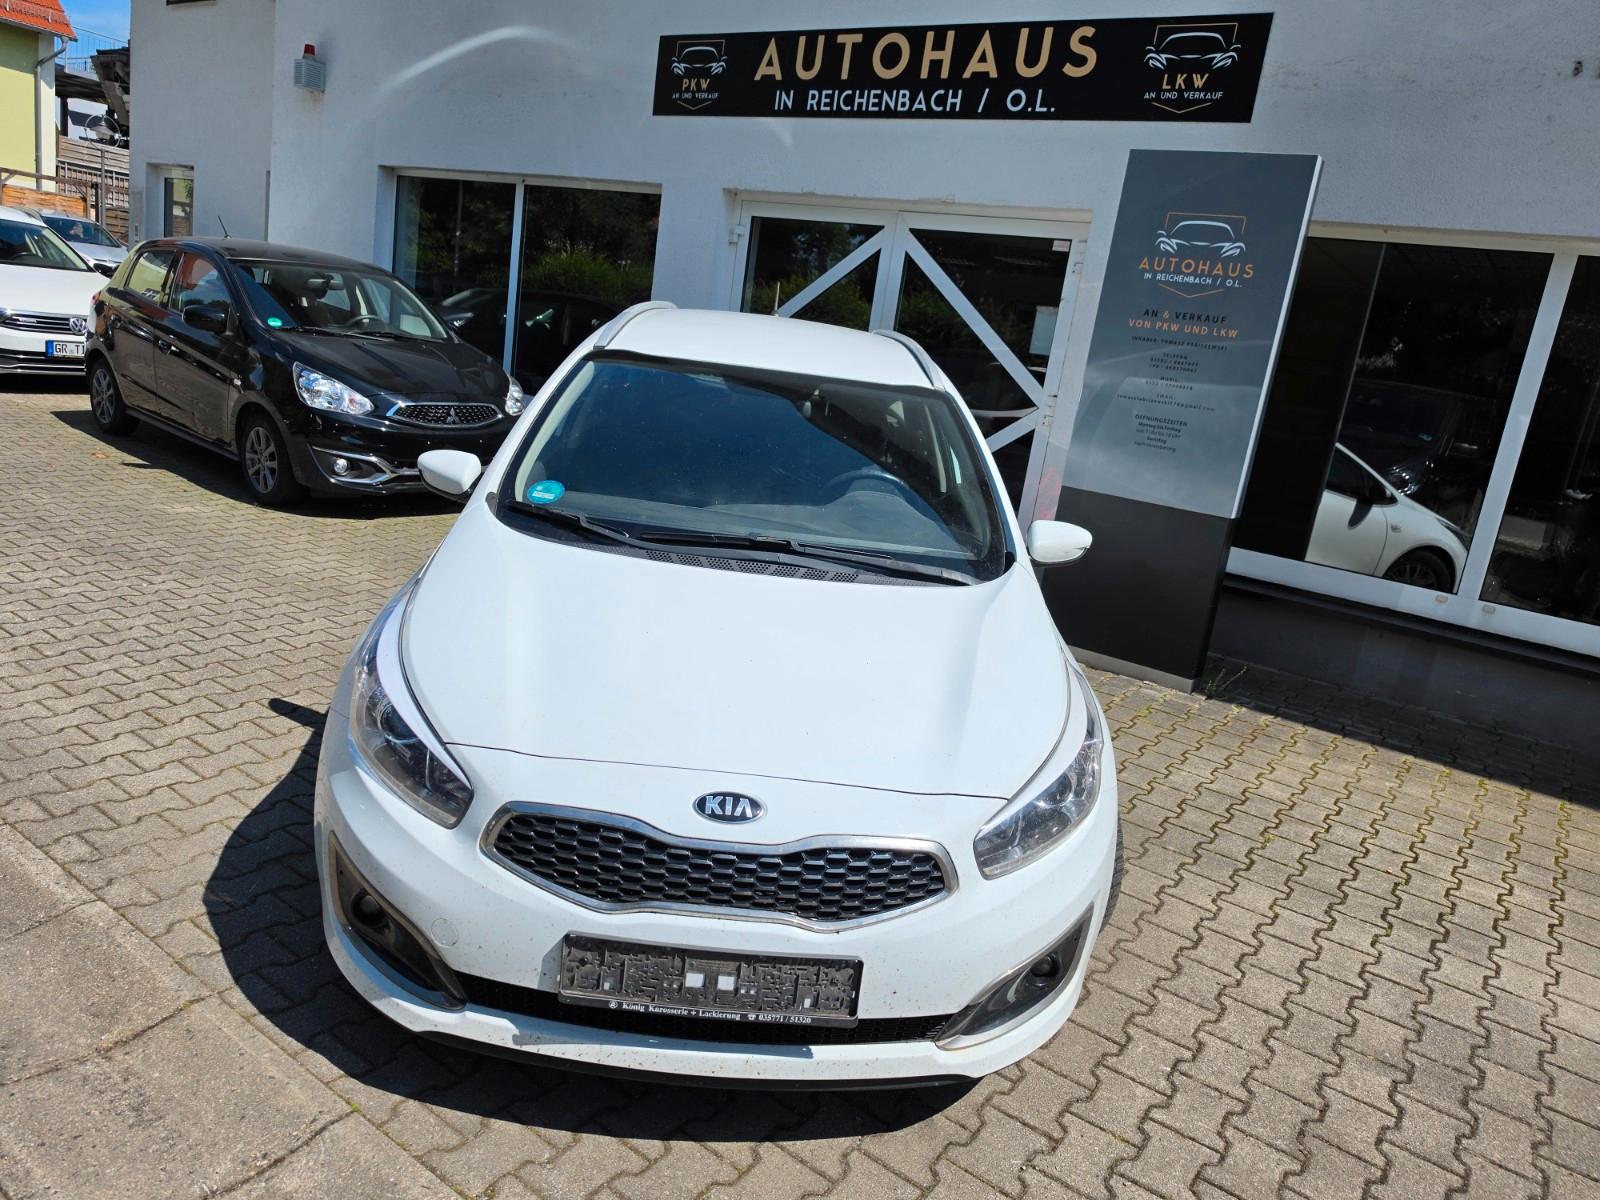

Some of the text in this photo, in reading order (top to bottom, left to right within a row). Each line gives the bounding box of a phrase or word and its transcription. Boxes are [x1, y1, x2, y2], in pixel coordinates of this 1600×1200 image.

[754, 26, 1097, 80] AUTOHAUS
[682, 78, 710, 91] PKW
[1162, 73, 1209, 89] LKW
[774, 88, 1056, 113] IN REICHENBACH / O.L.
[1143, 91, 1224, 99] AN UND VERKAUF
[1139, 257, 1254, 278] AUTOHAUS
[1143, 272, 1152, 280] IN
[1156, 273, 1212, 285] REICHENBACH
[1225, 279, 1243, 288] O.L.
[1143, 309, 1227, 324] AN & VERKAUF
[1129, 318, 1238, 338] VON PKW UND LKW
[55, 343, 68, 354] GR
[704, 795, 753, 818] KIA
[622, 1002, 645, 1012] König
[649, 1004, 688, 1016] Karosserie
[699, 1010, 741, 1021] Lackierung
[758, 1014, 784, 1022] 035771
[790, 1015, 812, 1024] 51320
